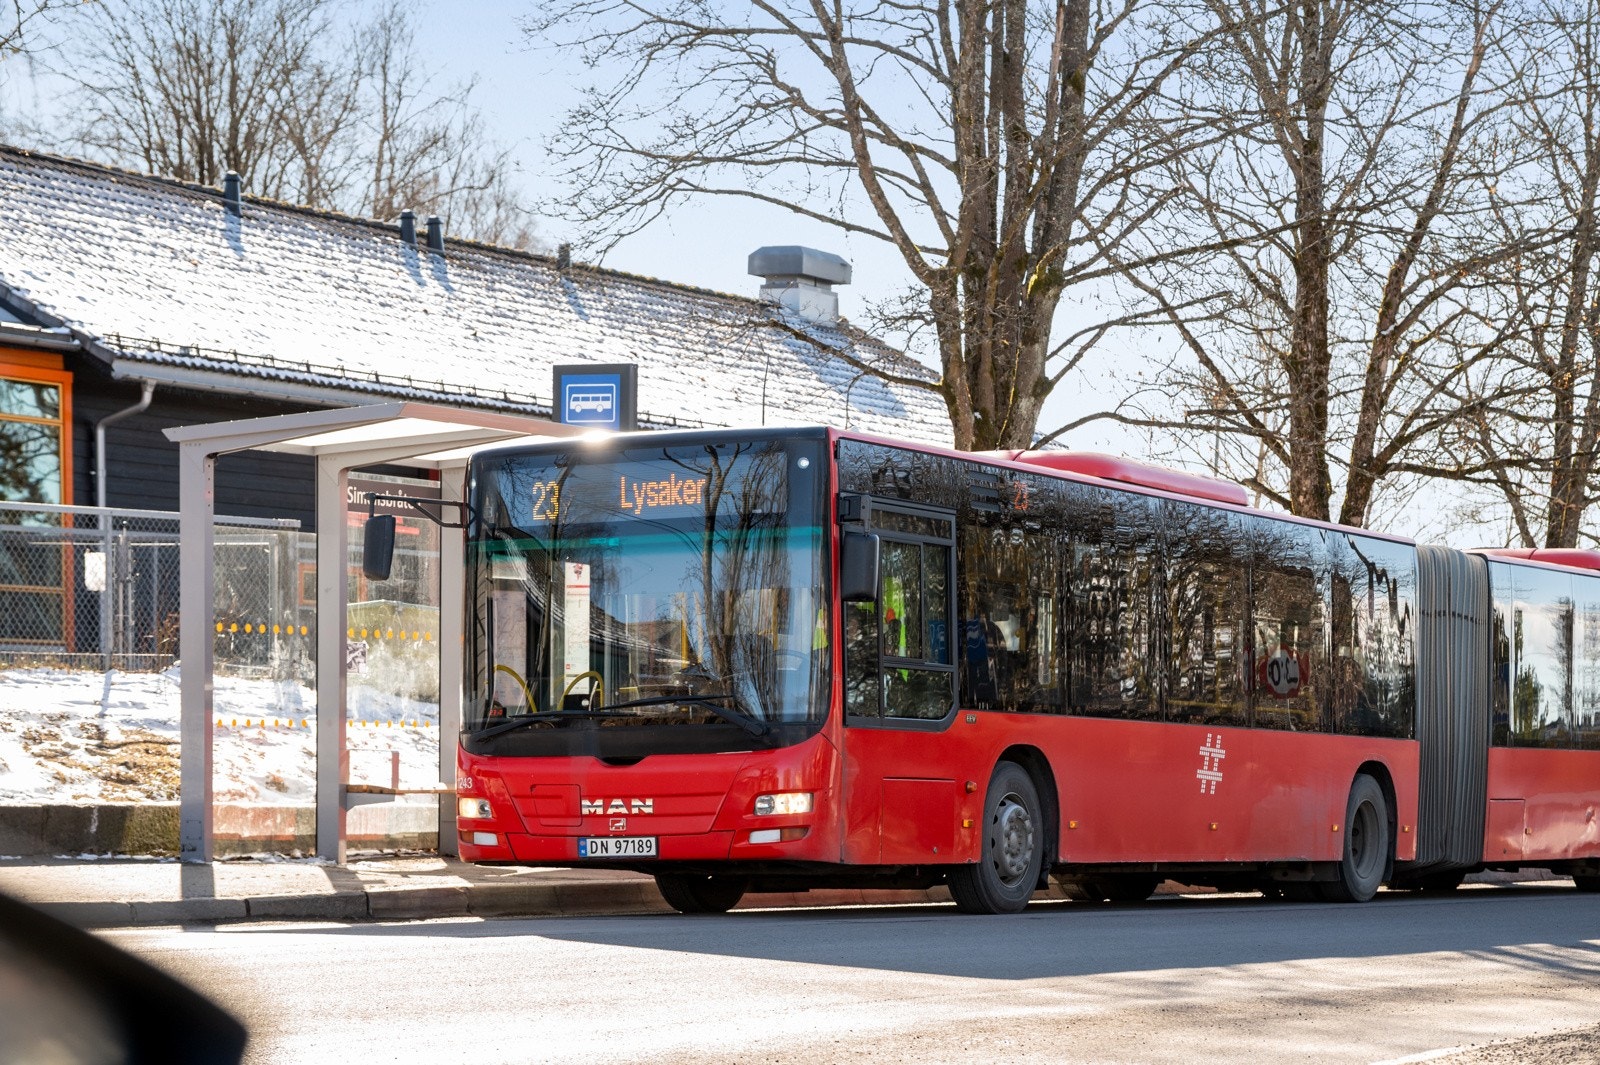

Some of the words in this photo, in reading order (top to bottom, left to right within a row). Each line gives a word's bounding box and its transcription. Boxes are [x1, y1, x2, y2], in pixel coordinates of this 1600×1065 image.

[532, 481, 559, 520] 23
[619, 473, 706, 514] Lysaker
[581, 798, 654, 815] MAN
[590, 840, 609, 854] DN
[614, 839, 653, 854] 97189
